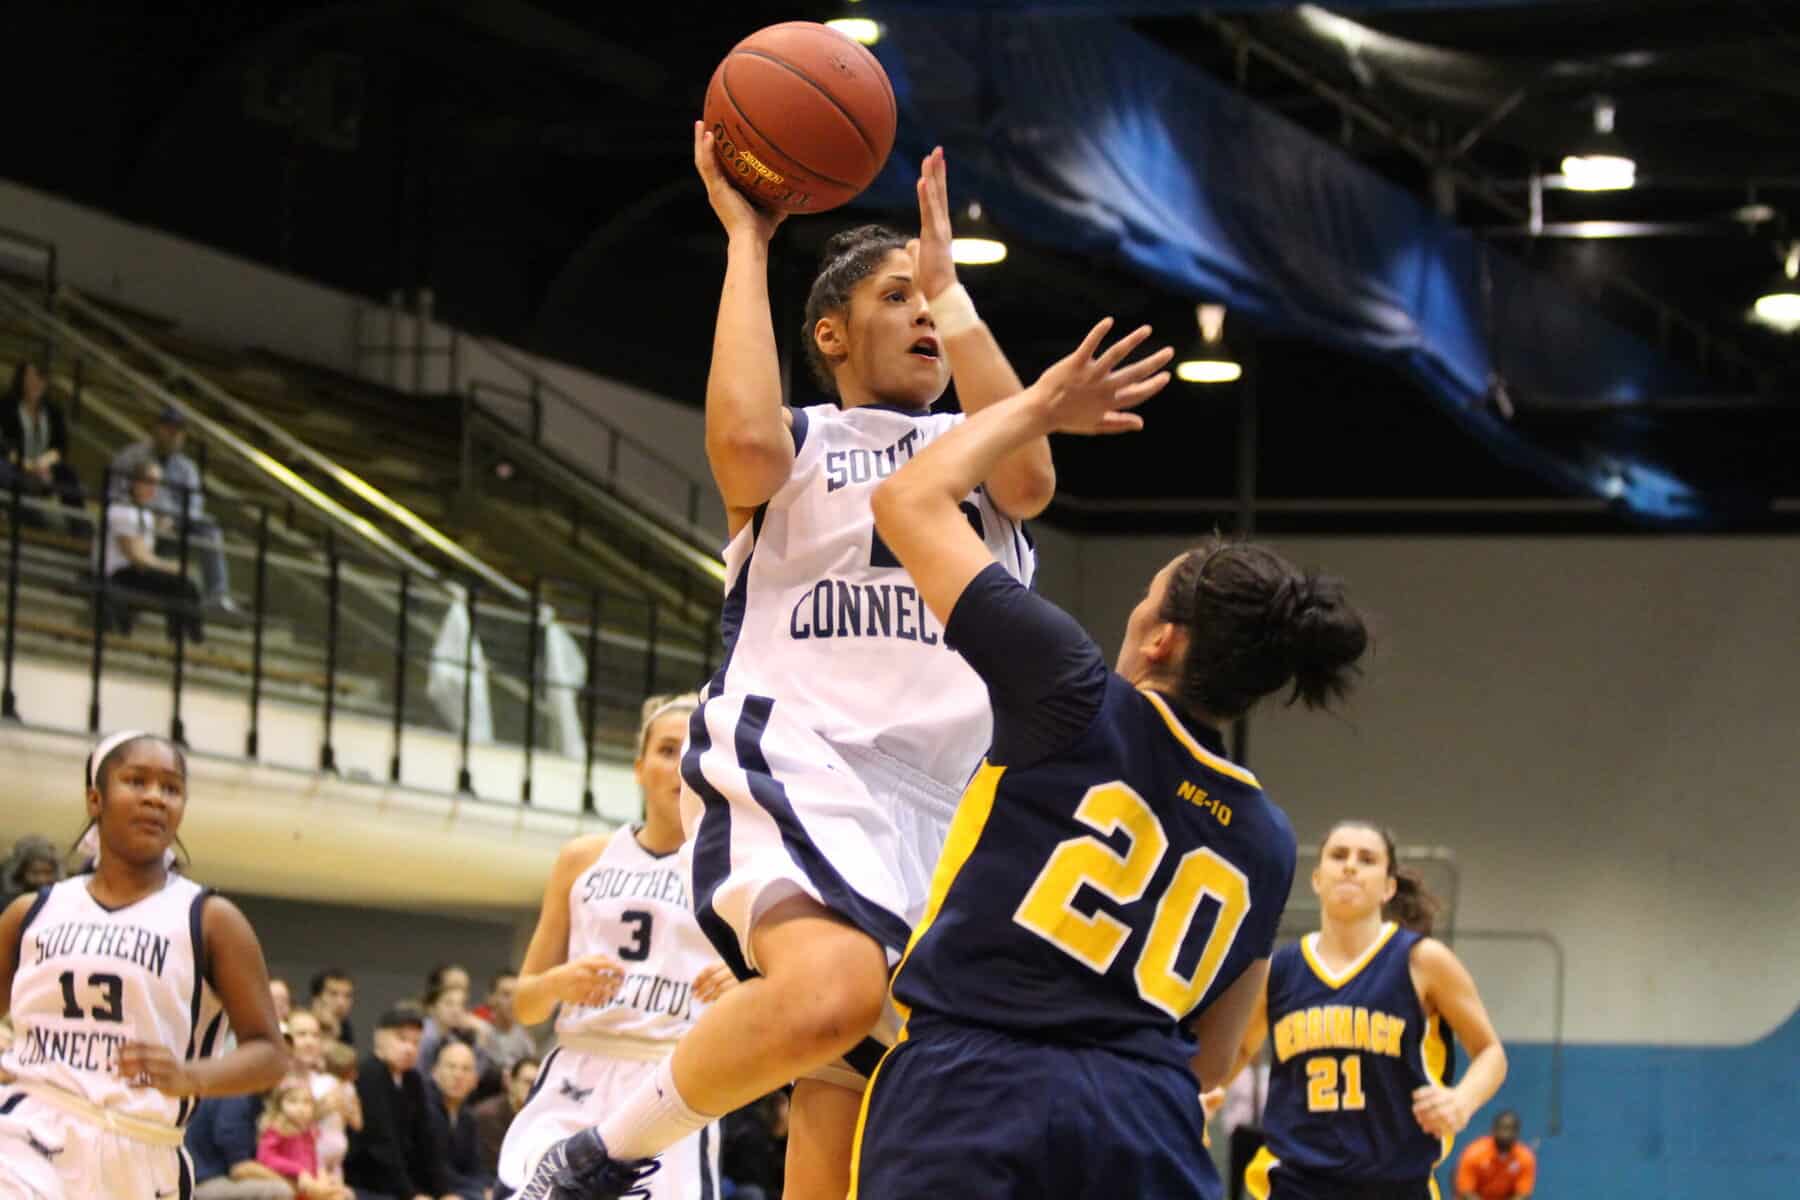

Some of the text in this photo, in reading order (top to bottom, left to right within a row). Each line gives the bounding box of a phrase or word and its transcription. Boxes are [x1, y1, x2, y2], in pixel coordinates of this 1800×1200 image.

[826, 428, 927, 493] SOUT
[1176, 780, 1232, 827] NE-10
[1012, 780, 1251, 1022] 20
[34, 921, 170, 977] SOUTHERN
[618, 910, 654, 961] 3
[59, 971, 123, 1023] 13
[1306, 1054, 1365, 1112] 21
